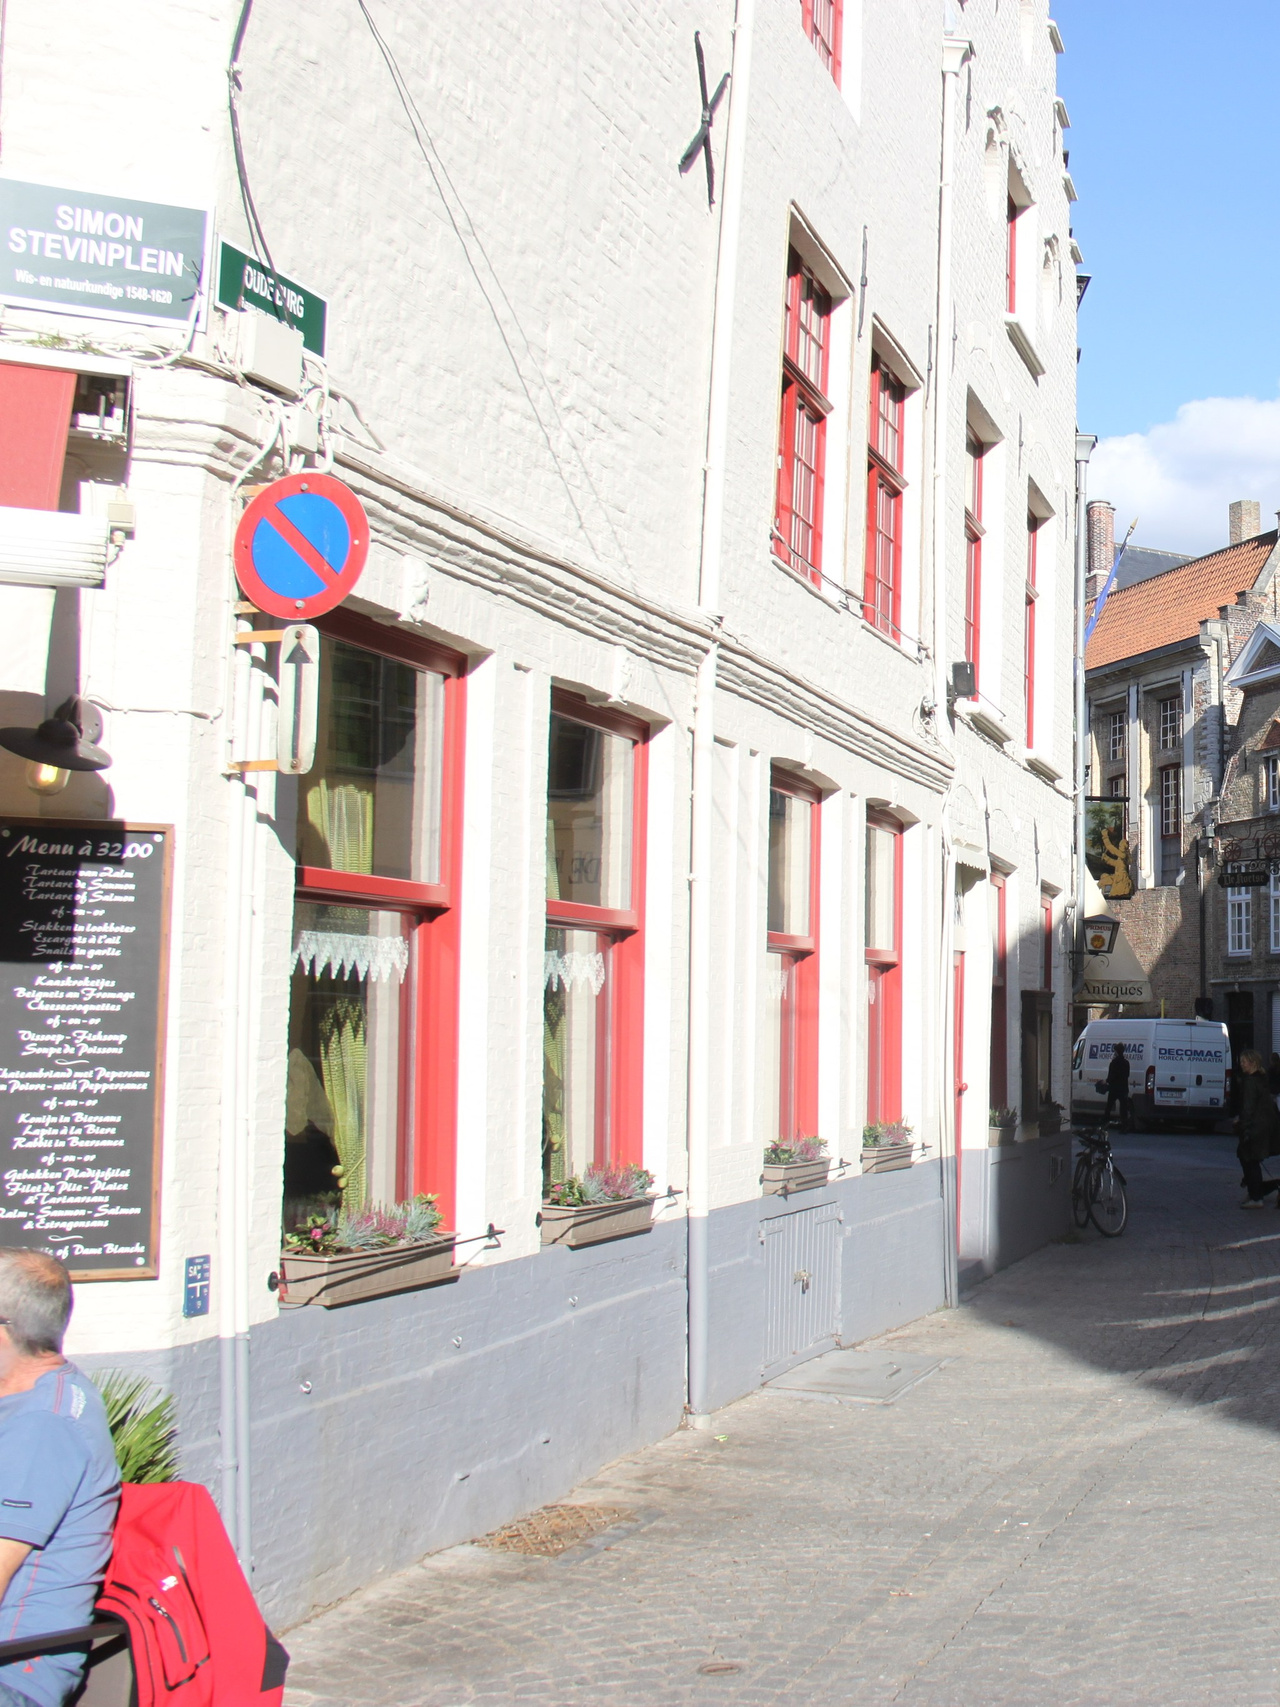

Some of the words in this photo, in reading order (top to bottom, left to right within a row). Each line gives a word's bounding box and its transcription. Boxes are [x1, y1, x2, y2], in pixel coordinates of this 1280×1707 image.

[56, 205, 144, 241] SIMON
[8, 228, 184, 277] STEVINPLEIN
[15, 269, 38, 284] Wis-
[40, 276, 52, 287] en
[54, 276, 124, 300] natuurkundige
[125, 286, 172, 304] 1548-1620
[245, 265, 275, 301] OUDE
[7, 835, 74, 857] Menu
[78, 840, 92, 856] à
[97, 842, 154, 859] 32,00
[25, 864, 76, 877] Tartaar
[78, 870, 98, 878] van
[100, 866, 134, 878] Zalm
[22, 876, 72, 888] Tartare
[75, 879, 86, 888] de
[22, 888, 72, 900] Tartare
[74, 891, 87, 904] of
[88, 890, 135, 902] Salmon
[19, 920, 72, 932] Slakken
[33, 932, 86, 945] Escargots
[32, 944, 73, 956] Snails
[75, 948, 86, 956] in
[1082, 982, 1143, 998] Antiques
[21, 1043, 62, 1058] Soupe
[63, 1044, 76, 1054] de
[76, 1044, 124, 1056] Poissons
[1100, 1043, 1144, 1054] DECMAC
[1158, 1048, 1222, 1058] DECOMAC
[1188, 1056, 1222, 1064] APPARATEN
[22, 1124, 58, 1138] Lapin
[70, 1126, 82, 1135] la
[12, 1137, 52, 1150] Rabbit
[54, 1139, 66, 1148] in
[4, 1168, 62, 1182] Gebakken
[5, 1182, 42, 1196] Filet
[94, 1204, 142, 1217] Salmon
[56, 1246, 70, 1260] of
[72, 1244, 103, 1256] Dame
[104, 1242, 145, 1254] Blanche
